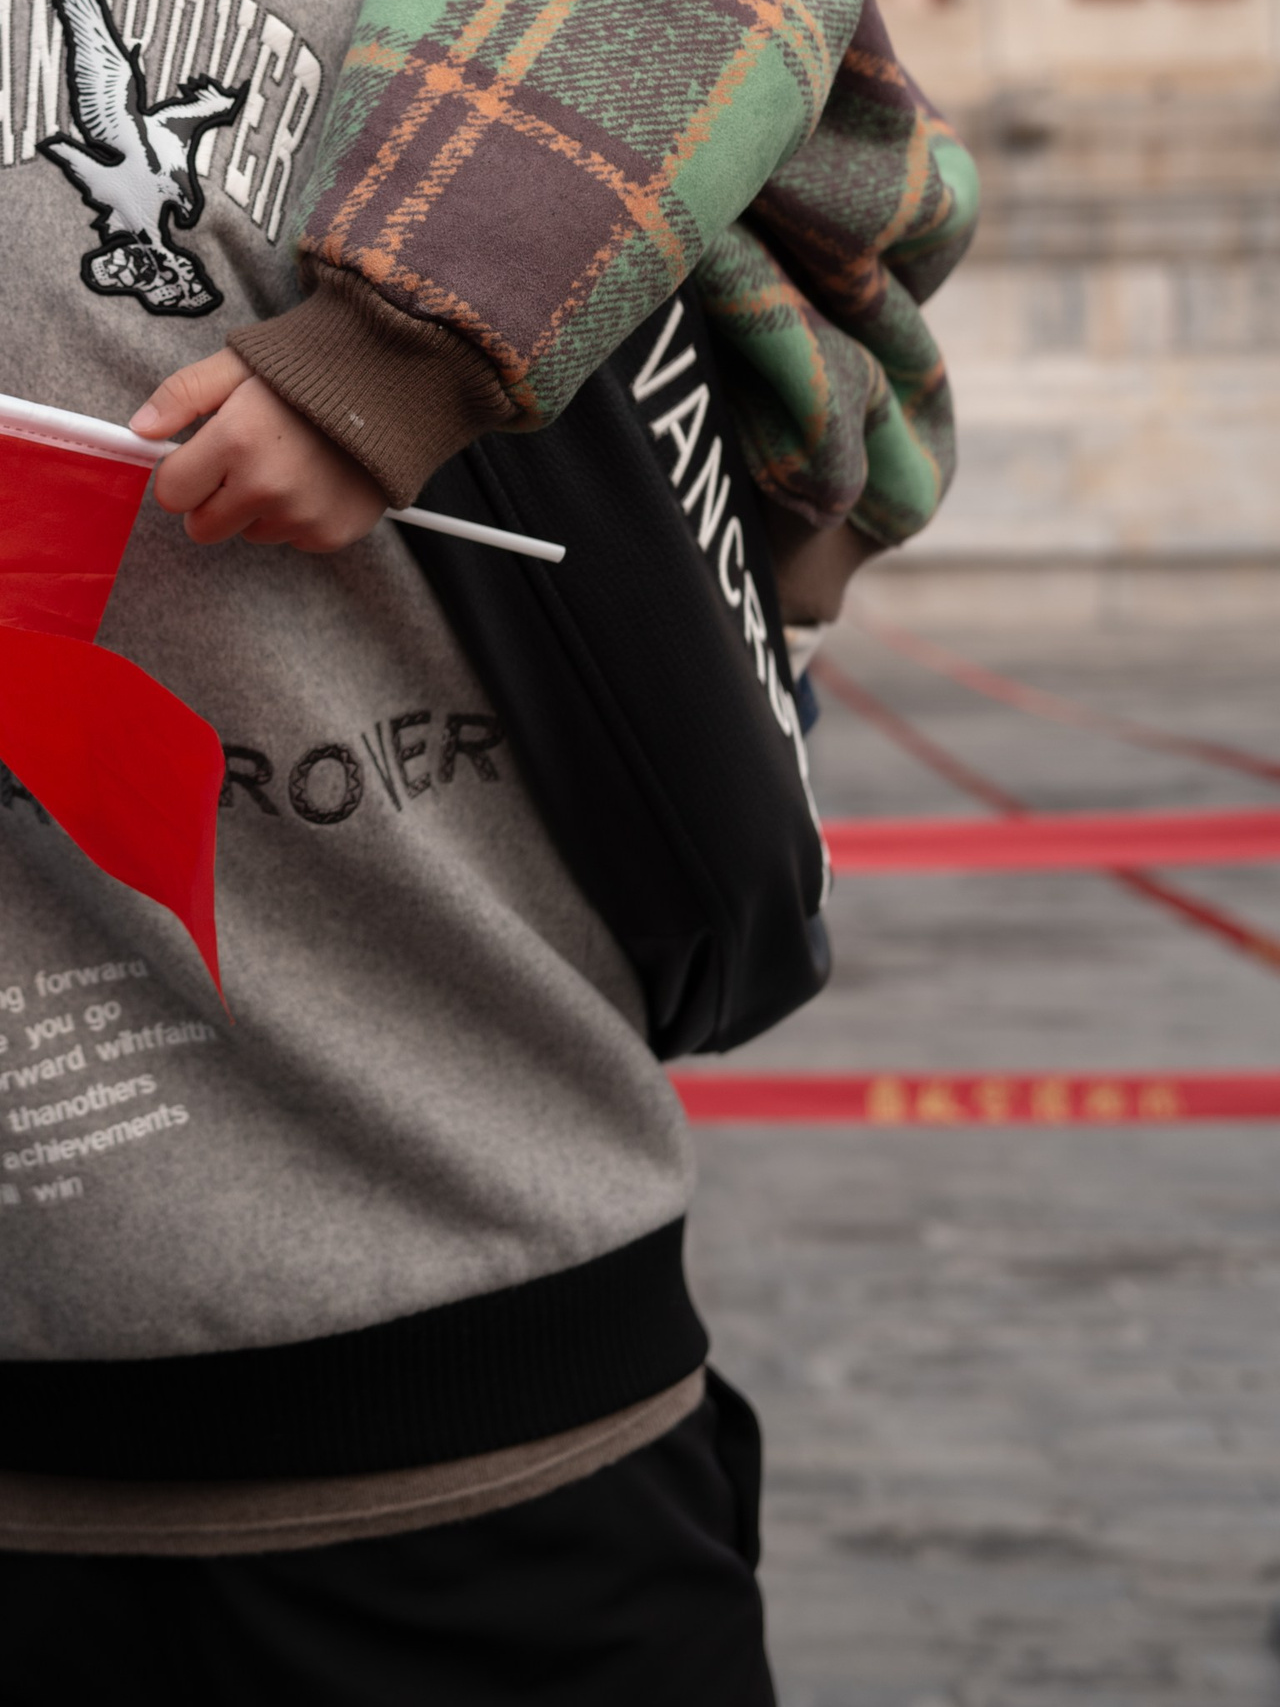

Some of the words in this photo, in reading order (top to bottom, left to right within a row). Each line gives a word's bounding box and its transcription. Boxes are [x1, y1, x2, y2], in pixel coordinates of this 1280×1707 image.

[35, 958, 149, 997] forward
[24, 1012, 75, 1051] you
[83, 999, 122, 1032] go
[7, 1072, 157, 1133] thanothers
[1, 1101, 190, 1171] achievements
[32, 1174, 84, 1203] win
